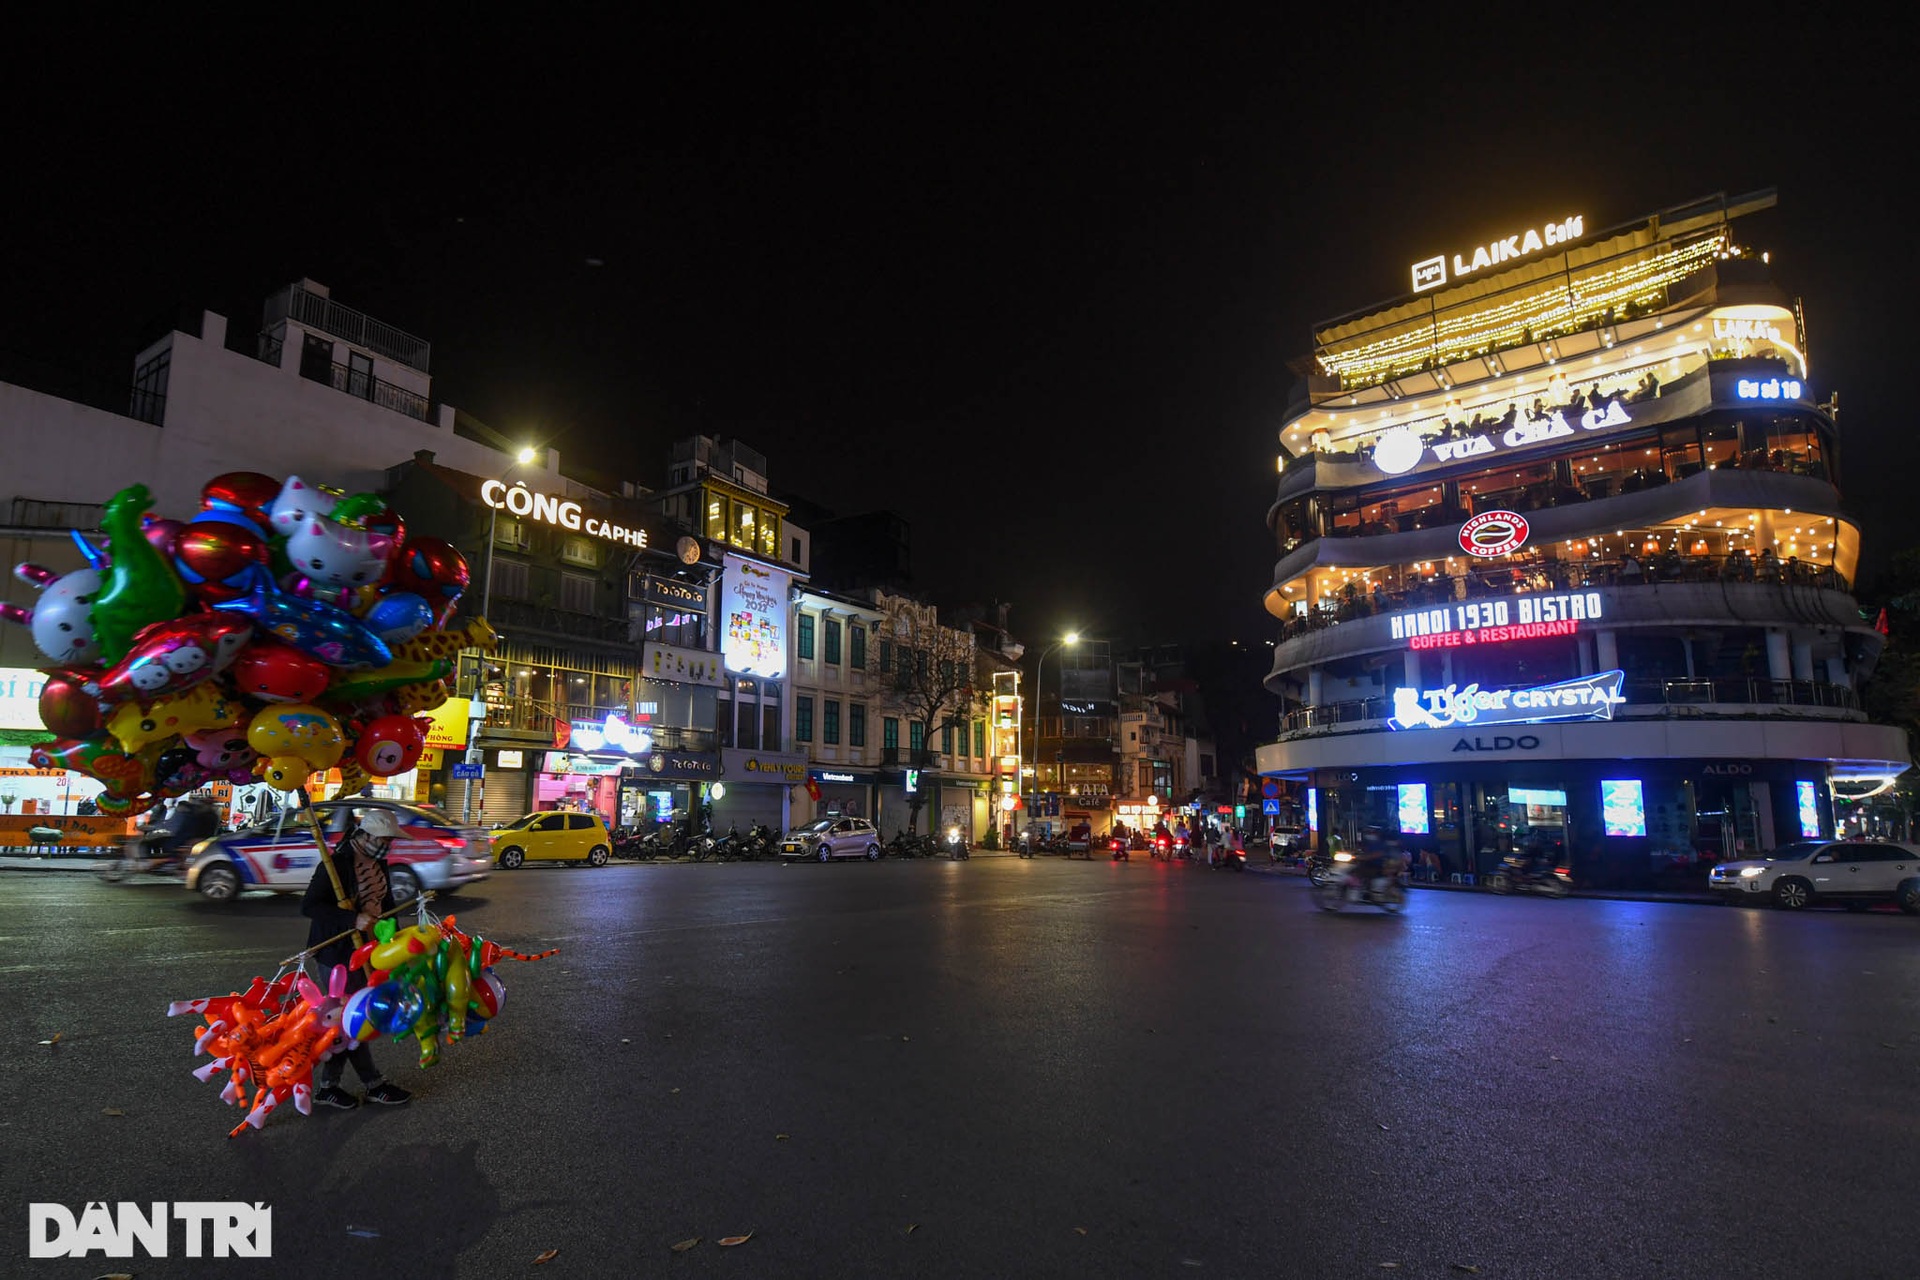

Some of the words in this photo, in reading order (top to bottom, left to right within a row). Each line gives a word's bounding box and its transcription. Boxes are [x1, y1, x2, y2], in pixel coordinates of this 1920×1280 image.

[1453, 229, 1544, 277] LAIKA
[1432, 434, 1496, 462] VUA
[1462, 513, 1525, 537] HIGHLANDS
[1471, 538, 1519, 555] COFFEE
[1391, 608, 1450, 639] HANOI
[1458, 601, 1509, 630] 1930
[1518, 593, 1602, 625] BISTRO
[1410, 633, 1461, 650] COFFEE
[1465, 630, 1476, 644] &
[1481, 619, 1579, 643] RESTAURANT
[1424, 683, 1511, 722] Tiger
[1513, 686, 1626, 708] CRYSTAL
[1452, 736, 1540, 752] ALDO
[1703, 764, 1752, 775] ALDO
